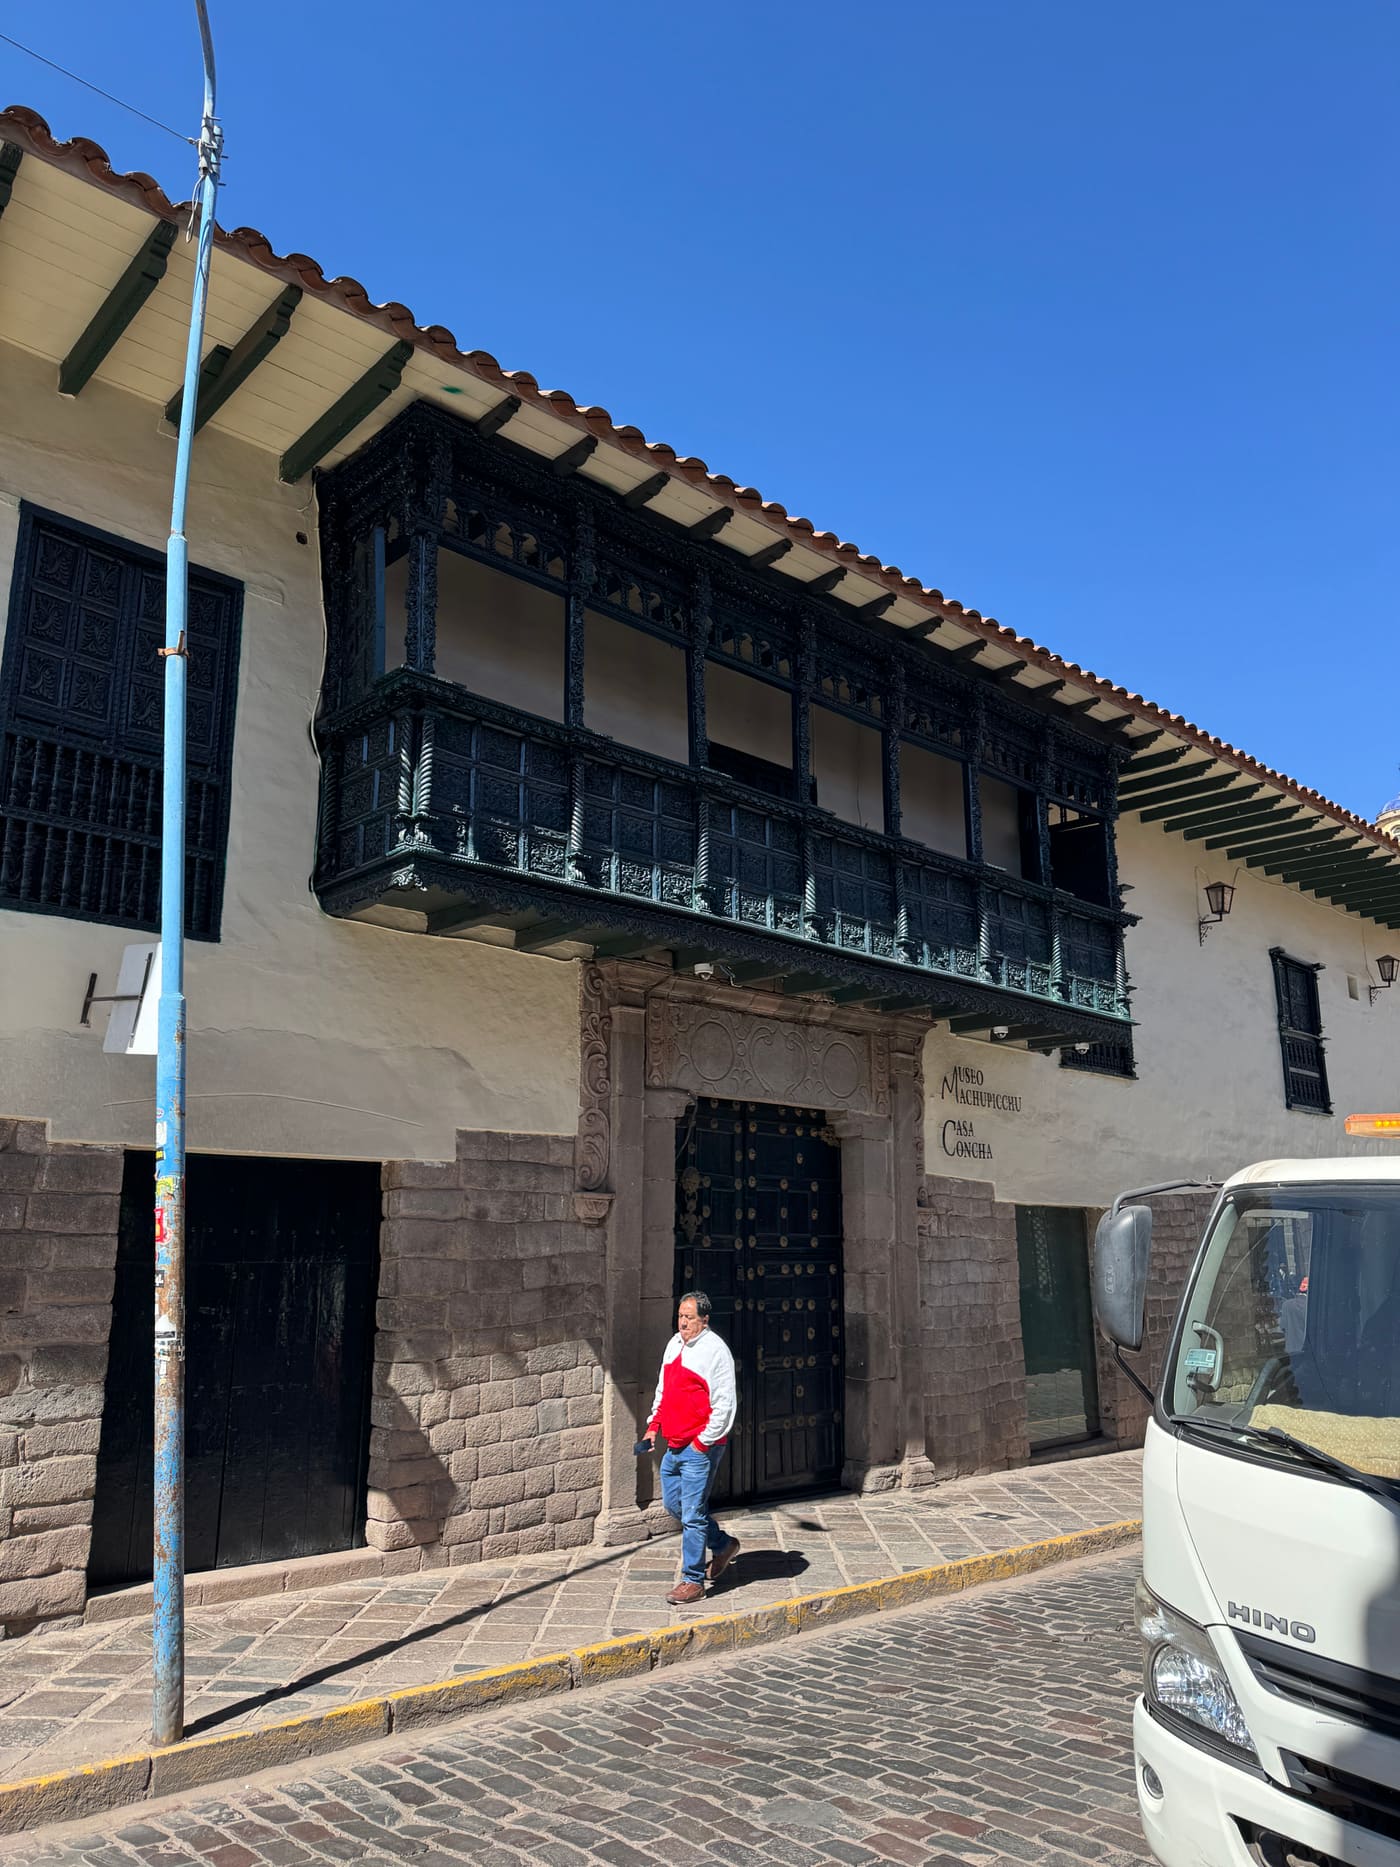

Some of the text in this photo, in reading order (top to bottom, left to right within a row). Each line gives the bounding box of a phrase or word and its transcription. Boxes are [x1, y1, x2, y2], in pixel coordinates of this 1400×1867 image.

[942, 1066, 984, 1096] MUSEO
[942, 1119, 974, 1146] CASA
[1227, 1600, 1316, 1644] HINO
